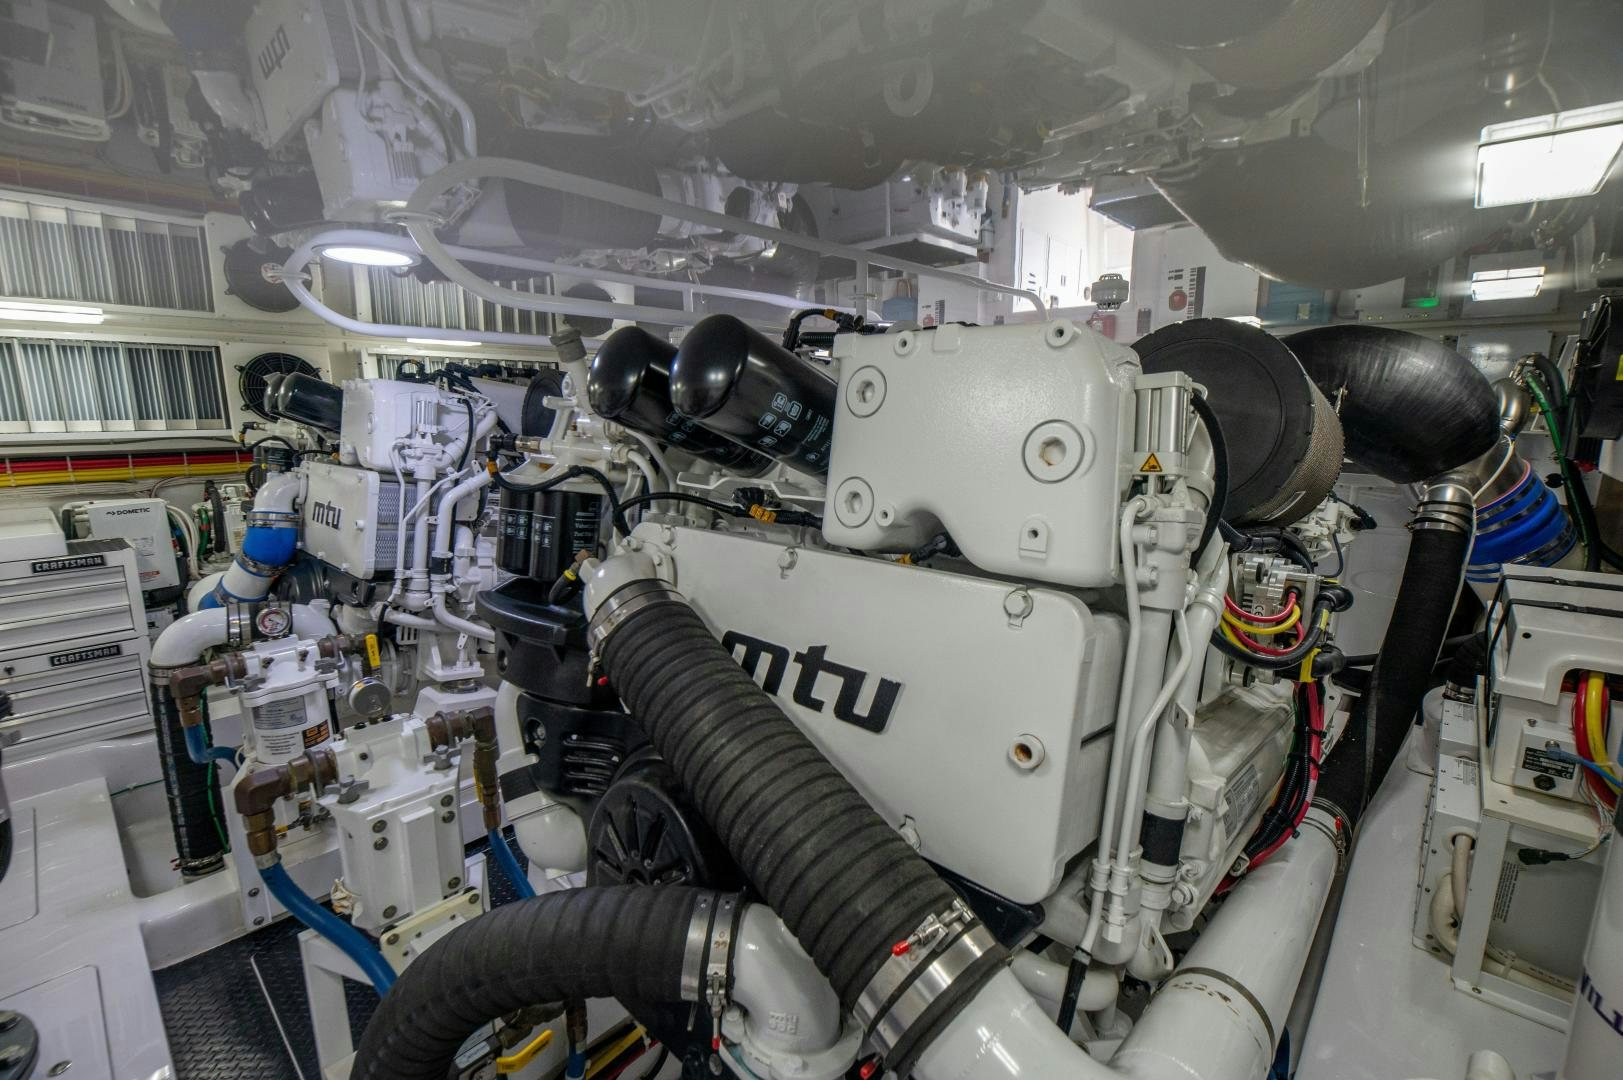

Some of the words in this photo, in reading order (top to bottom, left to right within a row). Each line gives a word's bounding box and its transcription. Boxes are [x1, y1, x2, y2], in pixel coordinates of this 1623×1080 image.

[117, 507, 151, 516] DOMETIC
[312, 500, 342, 530] mtu
[35, 557, 102, 571] CRAFTSMAN
[53, 646, 118, 664] CRAFTSMAN
[721, 629, 902, 734] mtu
